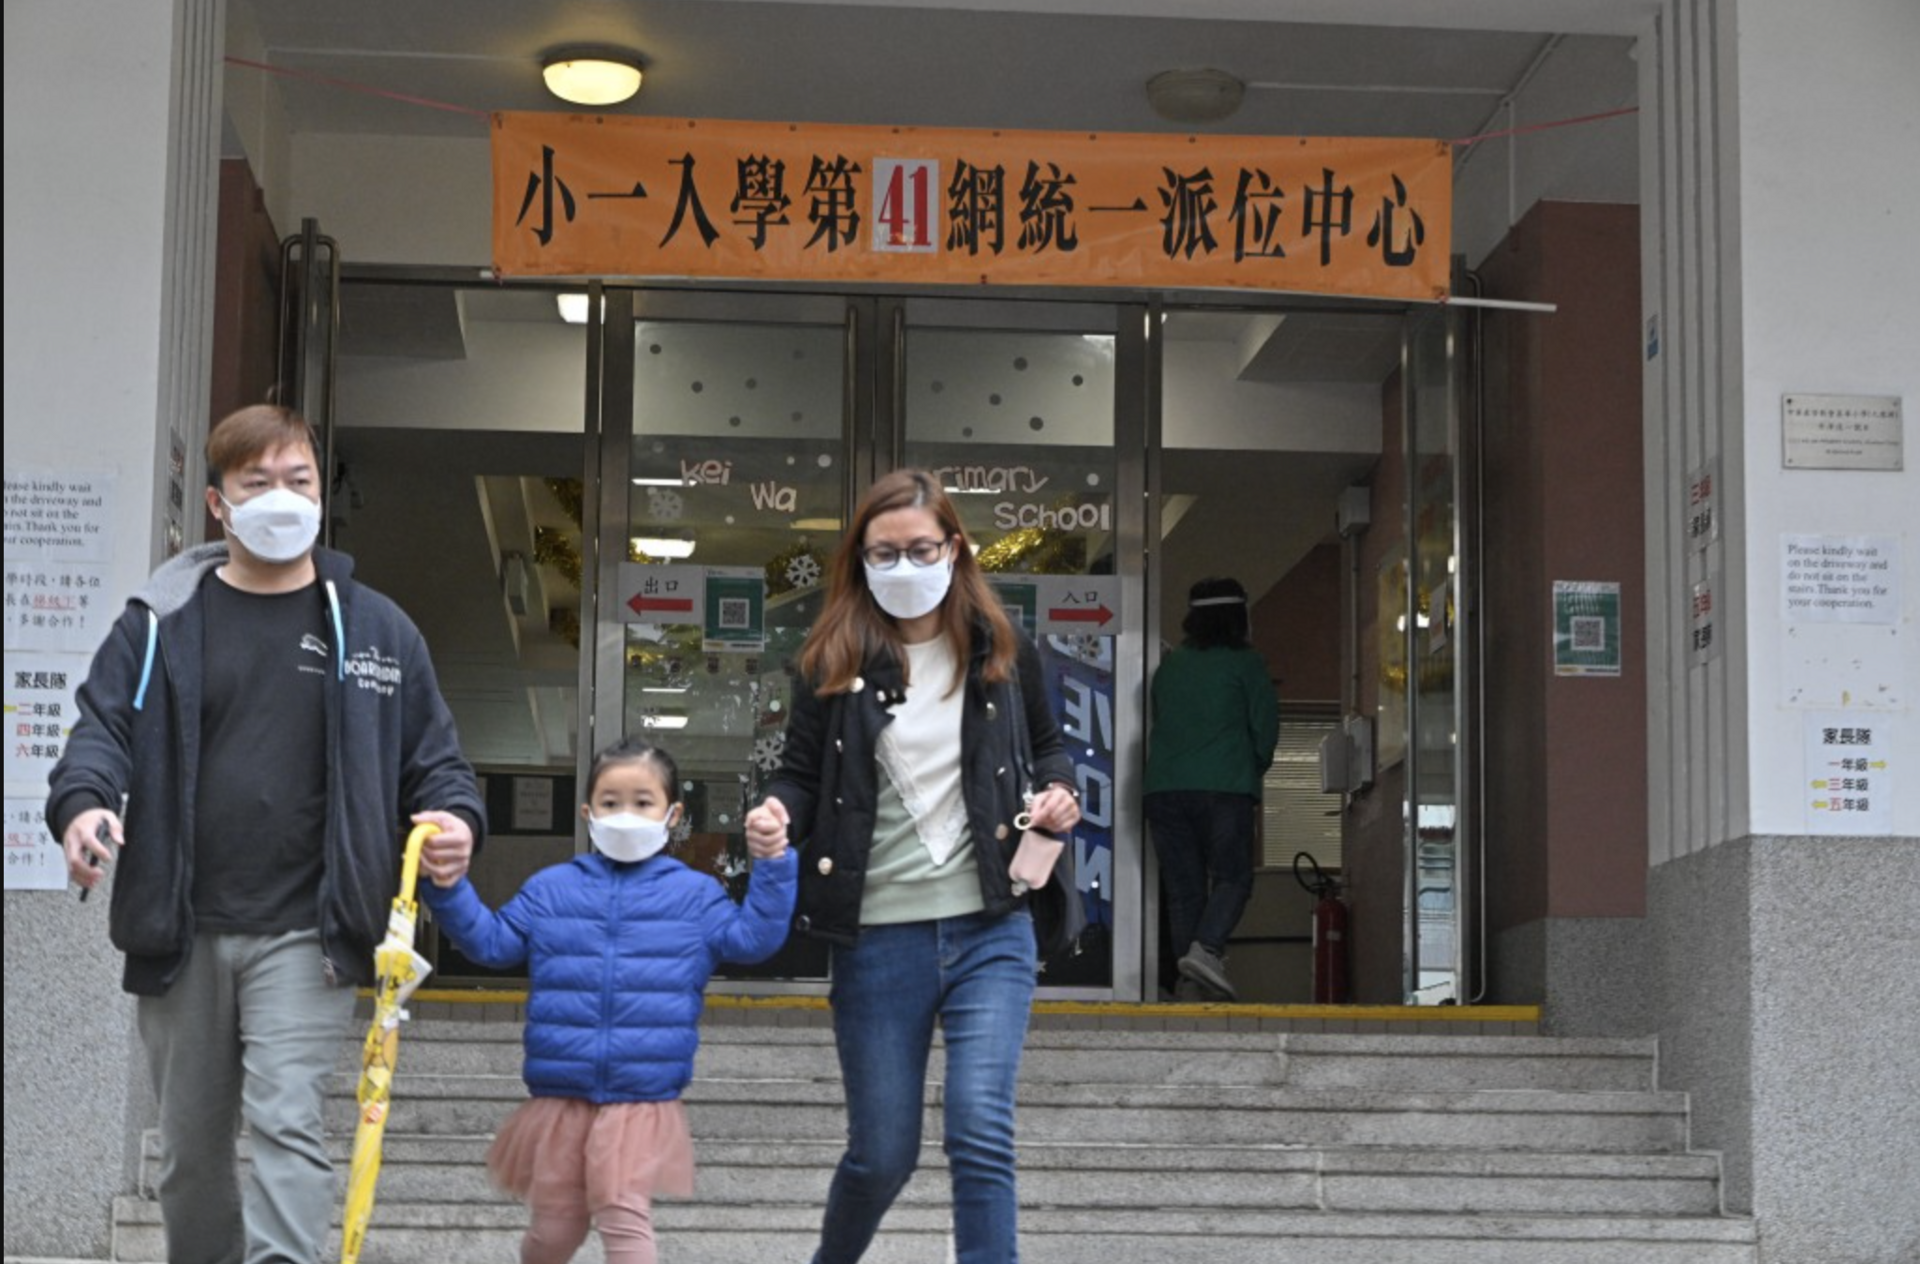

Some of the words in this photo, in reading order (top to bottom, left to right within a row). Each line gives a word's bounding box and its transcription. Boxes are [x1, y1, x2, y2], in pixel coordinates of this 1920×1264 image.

[514, 144, 1426, 267] 小一入學第41網統一派位中心
[932, 465, 1049, 493] rimary
[4, 480, 29, 492] lease
[32, 480, 65, 494] kindly
[69, 482, 91, 493] wait
[11, 494, 27, 505] the
[30, 494, 78, 508] driveway
[82, 495, 102, 507] and
[750, 480, 797, 512] Wa
[11, 508, 27, 518] not
[31, 508, 43, 518] sit
[62, 508, 79, 519] the
[26, 520, 57, 532] Thank
[61, 524, 82, 535] you
[84, 521, 99, 534] for
[20, 536, 84, 548] cooperation.
[1787, 544, 1820, 555] Please
[1822, 543, 1853, 559] kindly
[1856, 547, 1878, 556] wait
[1787, 559, 1800, 568] on
[1803, 558, 1819, 568] the
[1820, 559, 1867, 571] driveway
[1869, 559, 1888, 570] and
[1787, 570, 1800, 580] do
[1803, 571, 1819, 581] not
[1822, 571, 1834, 581] sit
[1836, 573, 1849, 581] on
[1852, 572, 1868, 582] the
[643, 575, 679, 594] 出口
[1850, 587, 1871, 598] you
[1873, 585, 1888, 596] for
[1062, 590, 1098, 604] 入口
[1788, 599, 1812, 609] your
[1813, 599, 1875, 610] cooperation.
[15, 671, 67, 690] 家長隊
[17, 702, 61, 717] 二年級
[16, 722, 61, 737] 四年級
[1822, 727, 1872, 745] 家長隊
[15, 744, 60, 759] 六年級
[1828, 757, 1868, 771] 一年級
[1828, 778, 1868, 791] 三年級
[1828, 797, 1869, 811] 五年級
